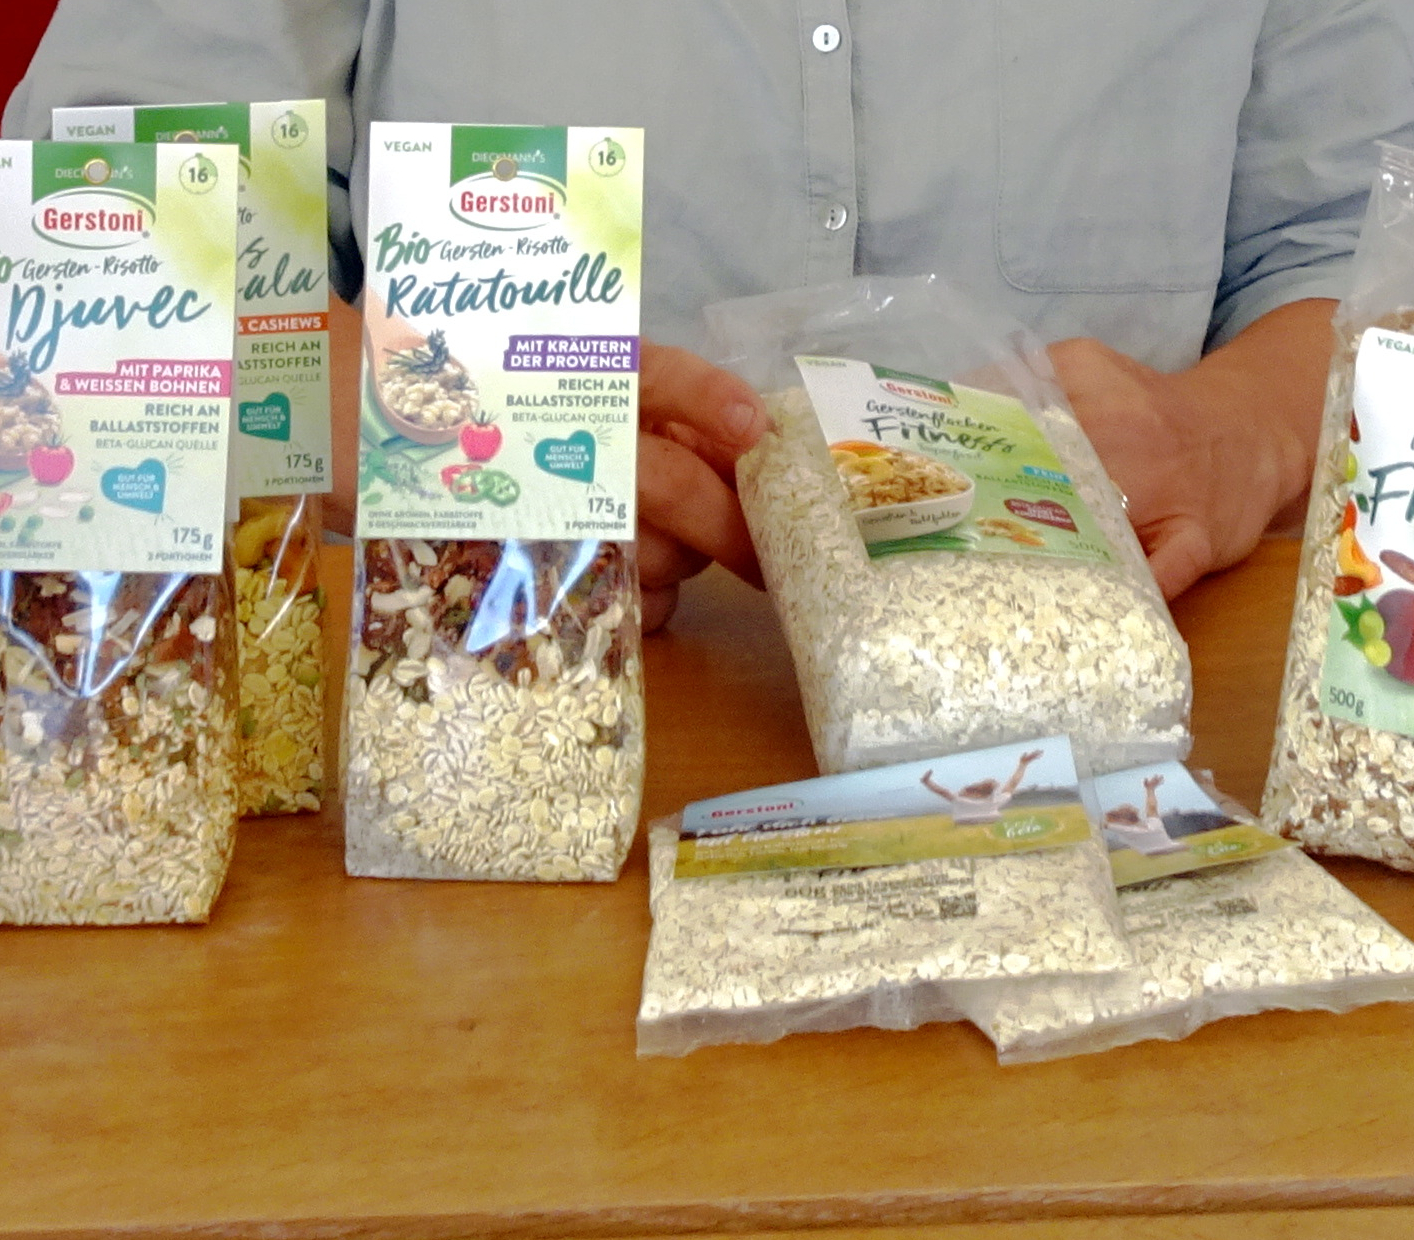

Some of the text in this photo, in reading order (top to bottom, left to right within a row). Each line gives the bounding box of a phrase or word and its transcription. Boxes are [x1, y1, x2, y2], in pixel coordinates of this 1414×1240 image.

[67, 124, 116, 138] VEGAN
[280, 122, 299, 138] 16
[384, 141, 432, 153] VEGAN
[597, 151, 616, 166] 16
[188, 167, 208, 183] 16
[460, 190, 555, 215] Gerstoni
[43, 207, 144, 232] Gerstoni
[374, 222, 442, 274] Bio
[387, 252, 624, 319] Ratatouille
[6, 283, 212, 374] Djuvec
[247, 316, 322, 332] CASHEWS
[251, 340, 321, 354] REICH AN
[516, 336, 632, 354] MIT KRÄUTERN
[511, 354, 632, 369] DER PROVENCE
[121, 363, 222, 379] MIT PAPRIKA
[282, 372, 322, 384] QUELLE
[59, 378, 221, 394] & WEISSEN BOHNEN
[558, 379, 630, 392] REICH AN
[885, 381, 953, 406] Gerstoni
[506, 394, 630, 408] BALLASTSTOFFEN
[144, 403, 221, 418] REICH AN
[511, 412, 629, 425] BETA-GLUCAN QUELLE
[866, 398, 1000, 433] Gerstenflocken
[89, 419, 221, 435] BALLASTSTOFFEN
[862, 415, 1017, 454] Fitness
[95, 437, 219, 452] BETA-GLUCAN QUELLE
[549, 444, 567, 453] GUT
[545, 453, 581, 462] MENSCH
[549, 461, 585, 470] UMWELT
[1328, 686, 1365, 717] 500g
